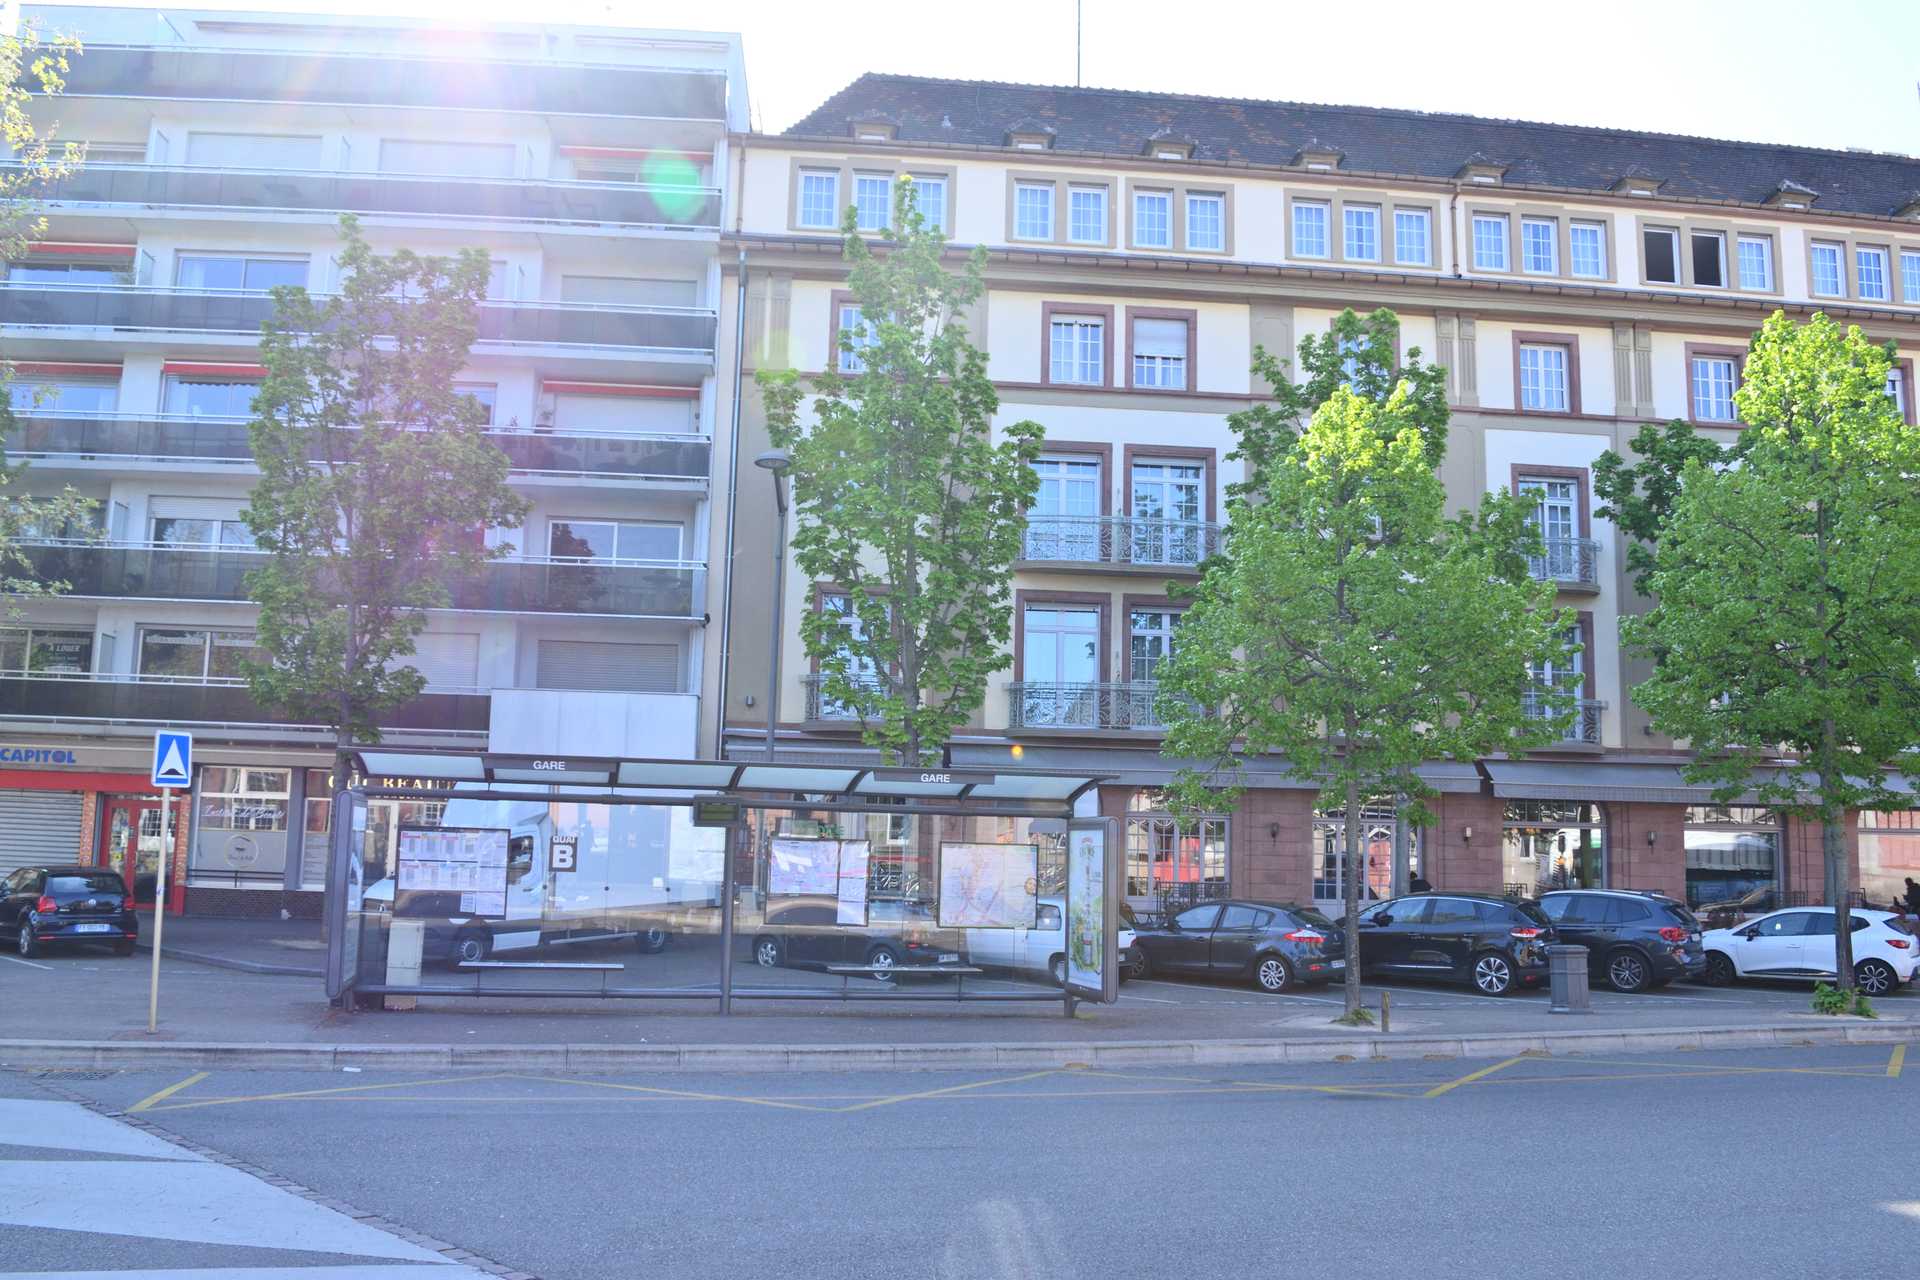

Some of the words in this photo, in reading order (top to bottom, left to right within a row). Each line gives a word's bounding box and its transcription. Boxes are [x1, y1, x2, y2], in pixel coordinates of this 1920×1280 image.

[0, 747, 77, 764] CAPITOL
[533, 760, 566, 771] GARE
[920, 773, 951, 783] GARE
[552, 844, 574, 869] B
